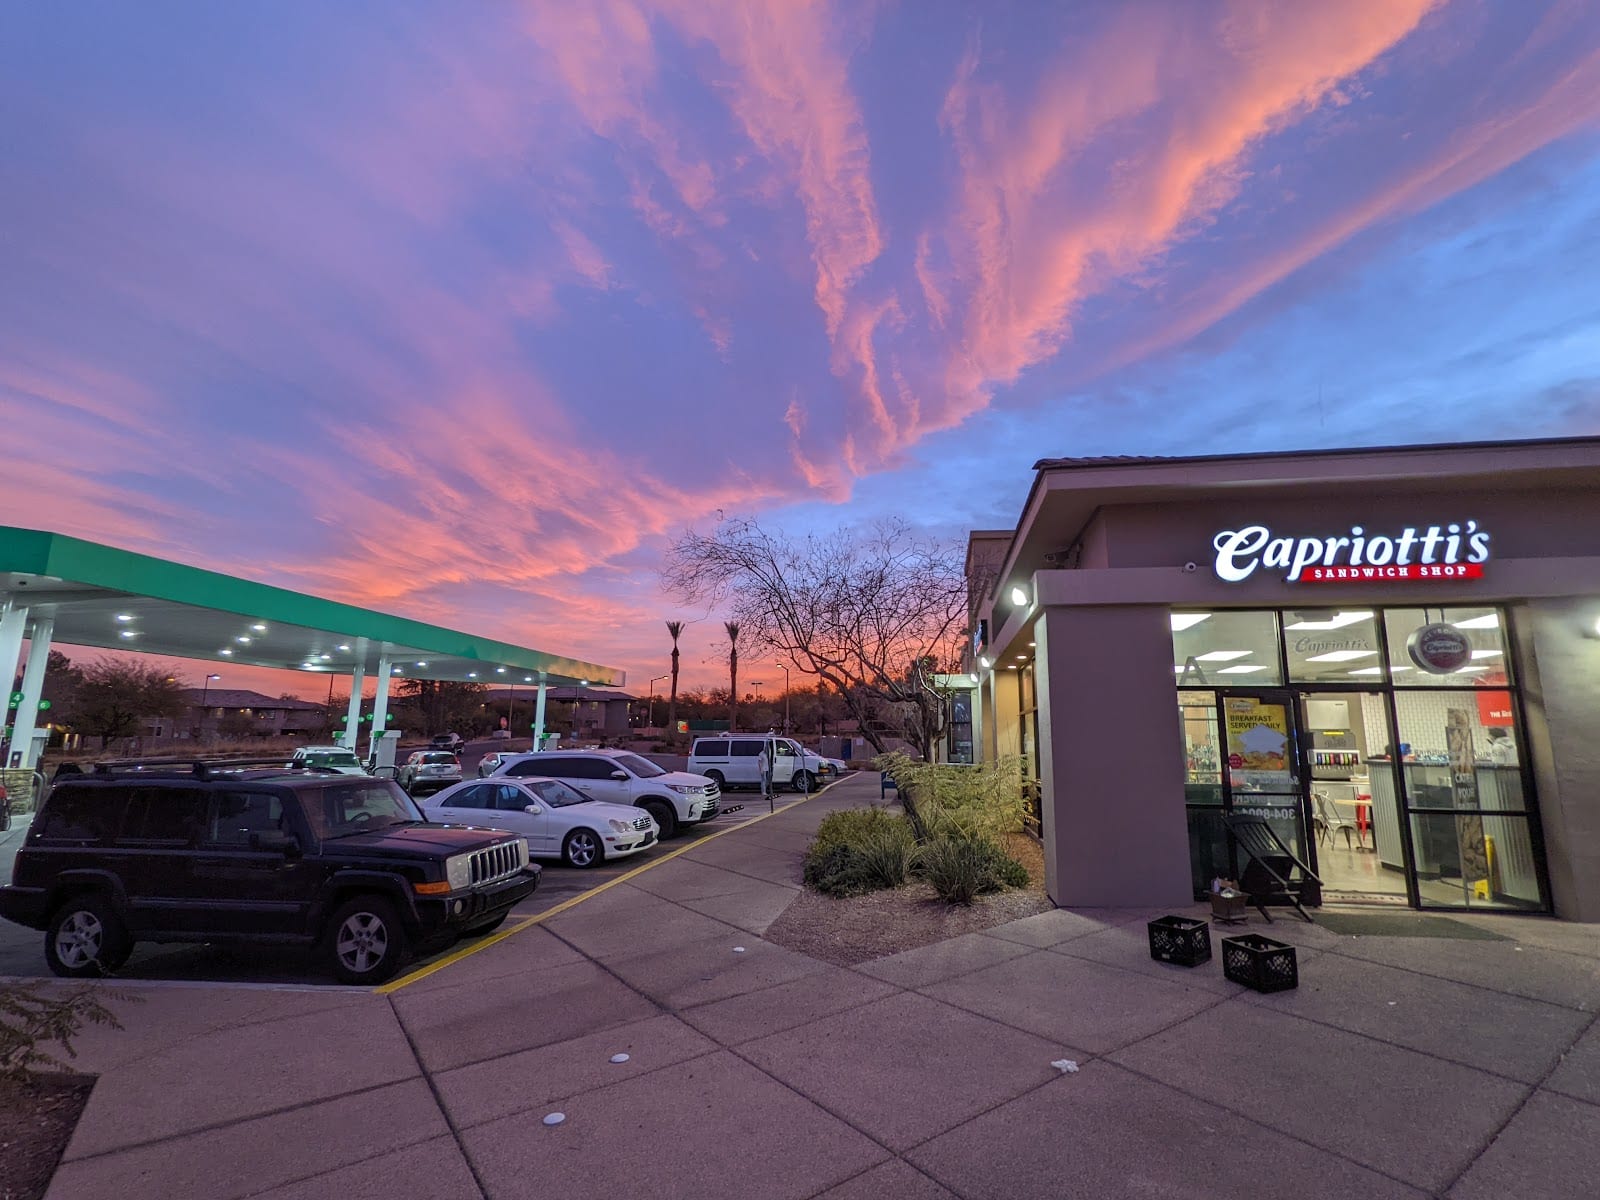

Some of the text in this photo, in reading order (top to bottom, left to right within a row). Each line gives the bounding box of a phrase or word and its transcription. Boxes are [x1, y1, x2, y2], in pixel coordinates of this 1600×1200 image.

[1212, 519, 1490, 582] Capriotti's
[1314, 565, 1467, 579] SANDWICH SHOP
[1294, 635, 1369, 654] Capriotti's
